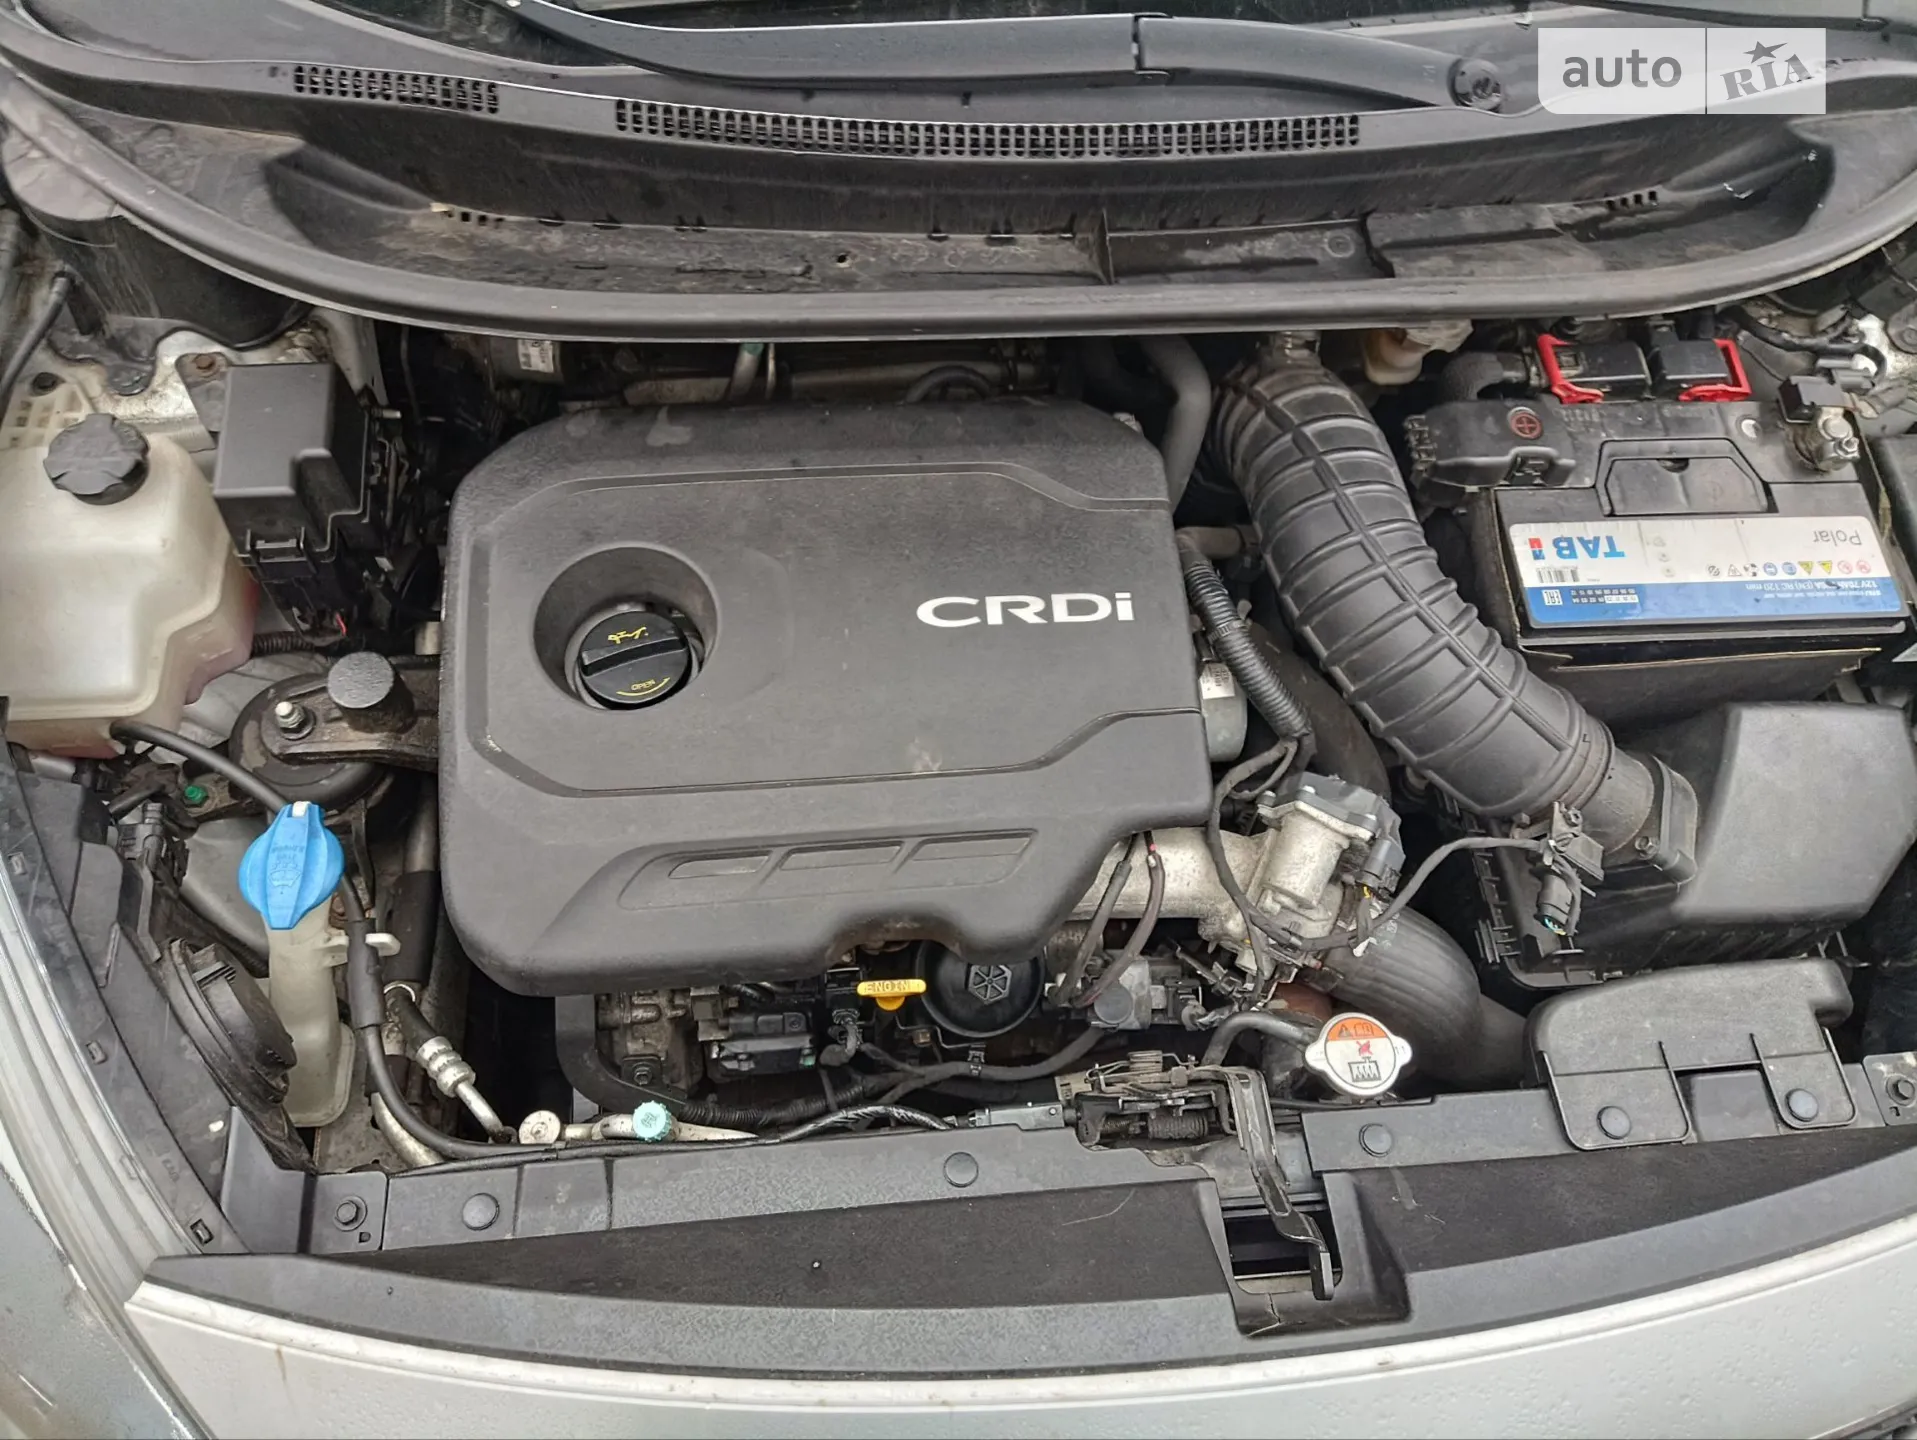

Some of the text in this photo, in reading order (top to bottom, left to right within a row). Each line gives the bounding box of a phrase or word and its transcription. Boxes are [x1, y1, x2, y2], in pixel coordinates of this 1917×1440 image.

[1813, 529, 1863, 546] Polar
[1553, 535, 1625, 559] TAB
[1745, 583, 1762, 592] min
[916, 592, 1135, 628] CRDi
[630, 679, 656, 692] OPEN
